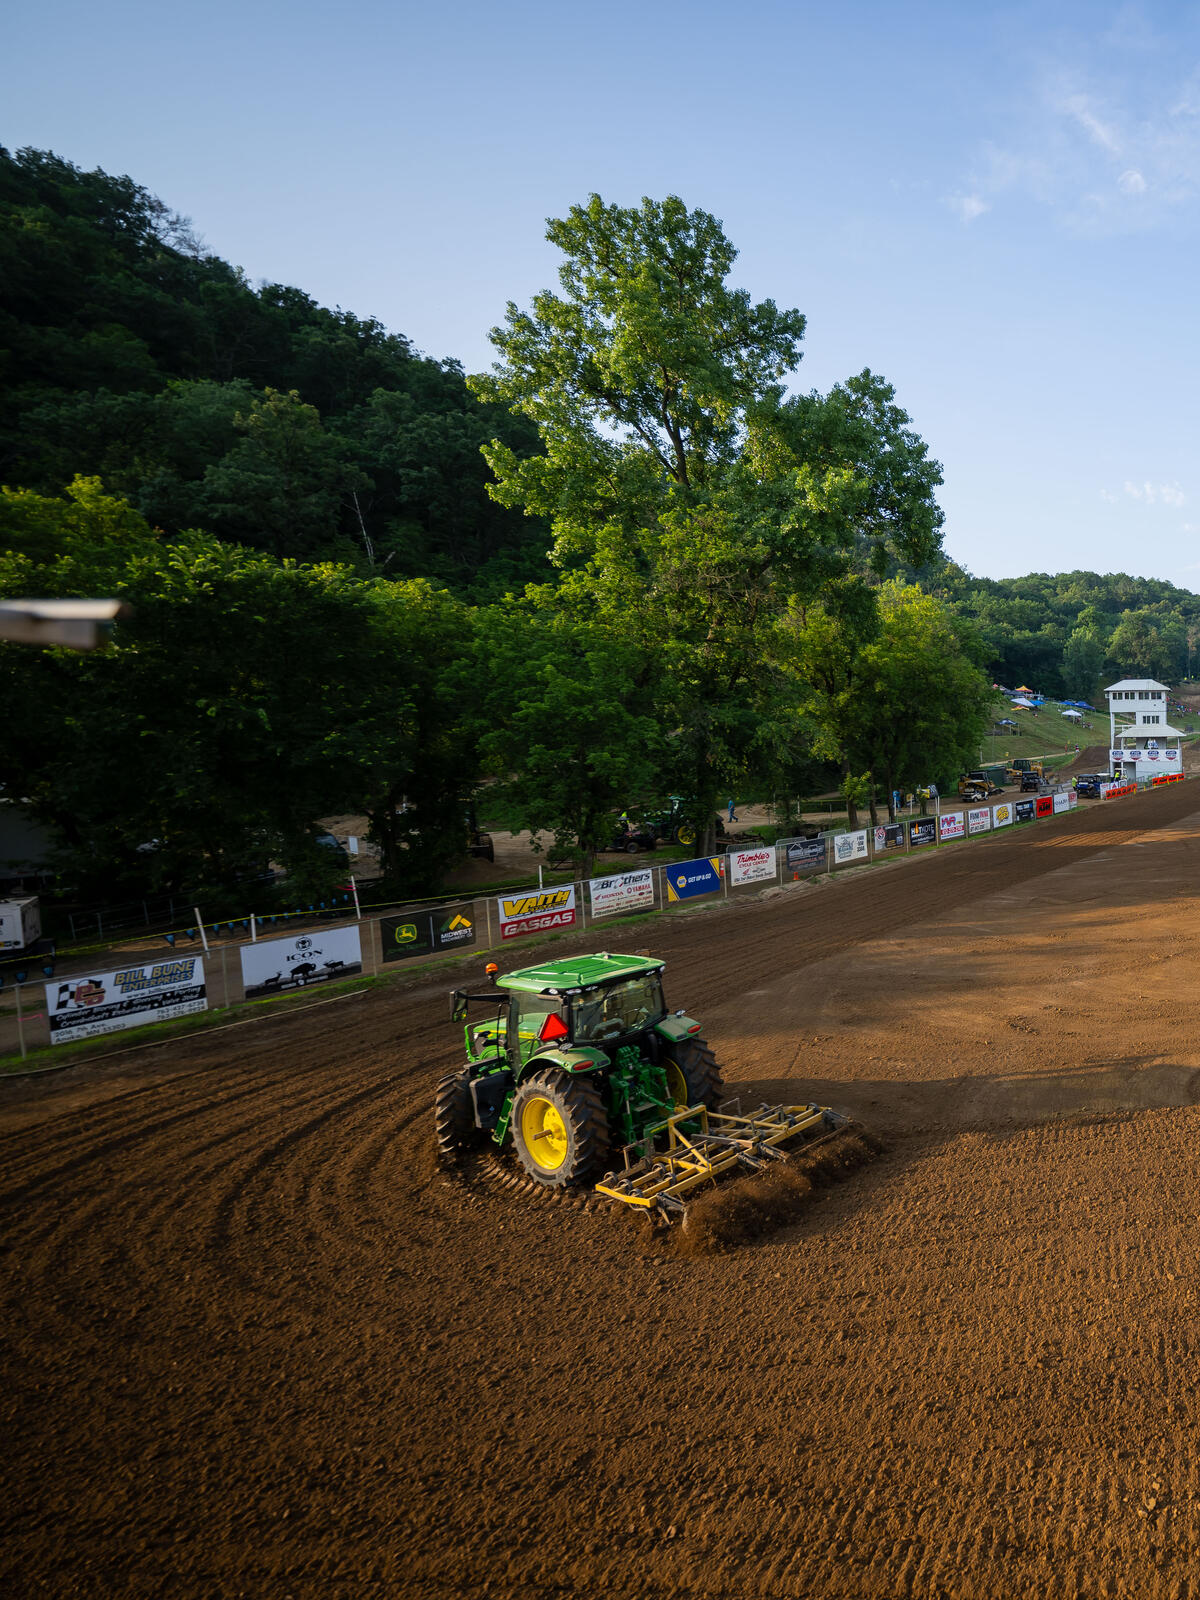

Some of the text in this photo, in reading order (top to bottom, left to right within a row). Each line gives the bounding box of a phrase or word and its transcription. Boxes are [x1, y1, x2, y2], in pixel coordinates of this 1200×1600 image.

[1038, 801, 1050, 813] KTM
[737, 852, 770, 864] Trimble's
[633, 883, 651, 892] YAMAHA
[601, 891, 624, 899] HONDA
[503, 890, 571, 917] VAITH
[504, 912, 573, 936] GASGAS
[441, 927, 473, 939] MIDWEST
[286, 949, 322, 962] ICON
[114, 959, 196, 986] BILL BUNE
[120, 972, 193, 994] ENTERPRISES
